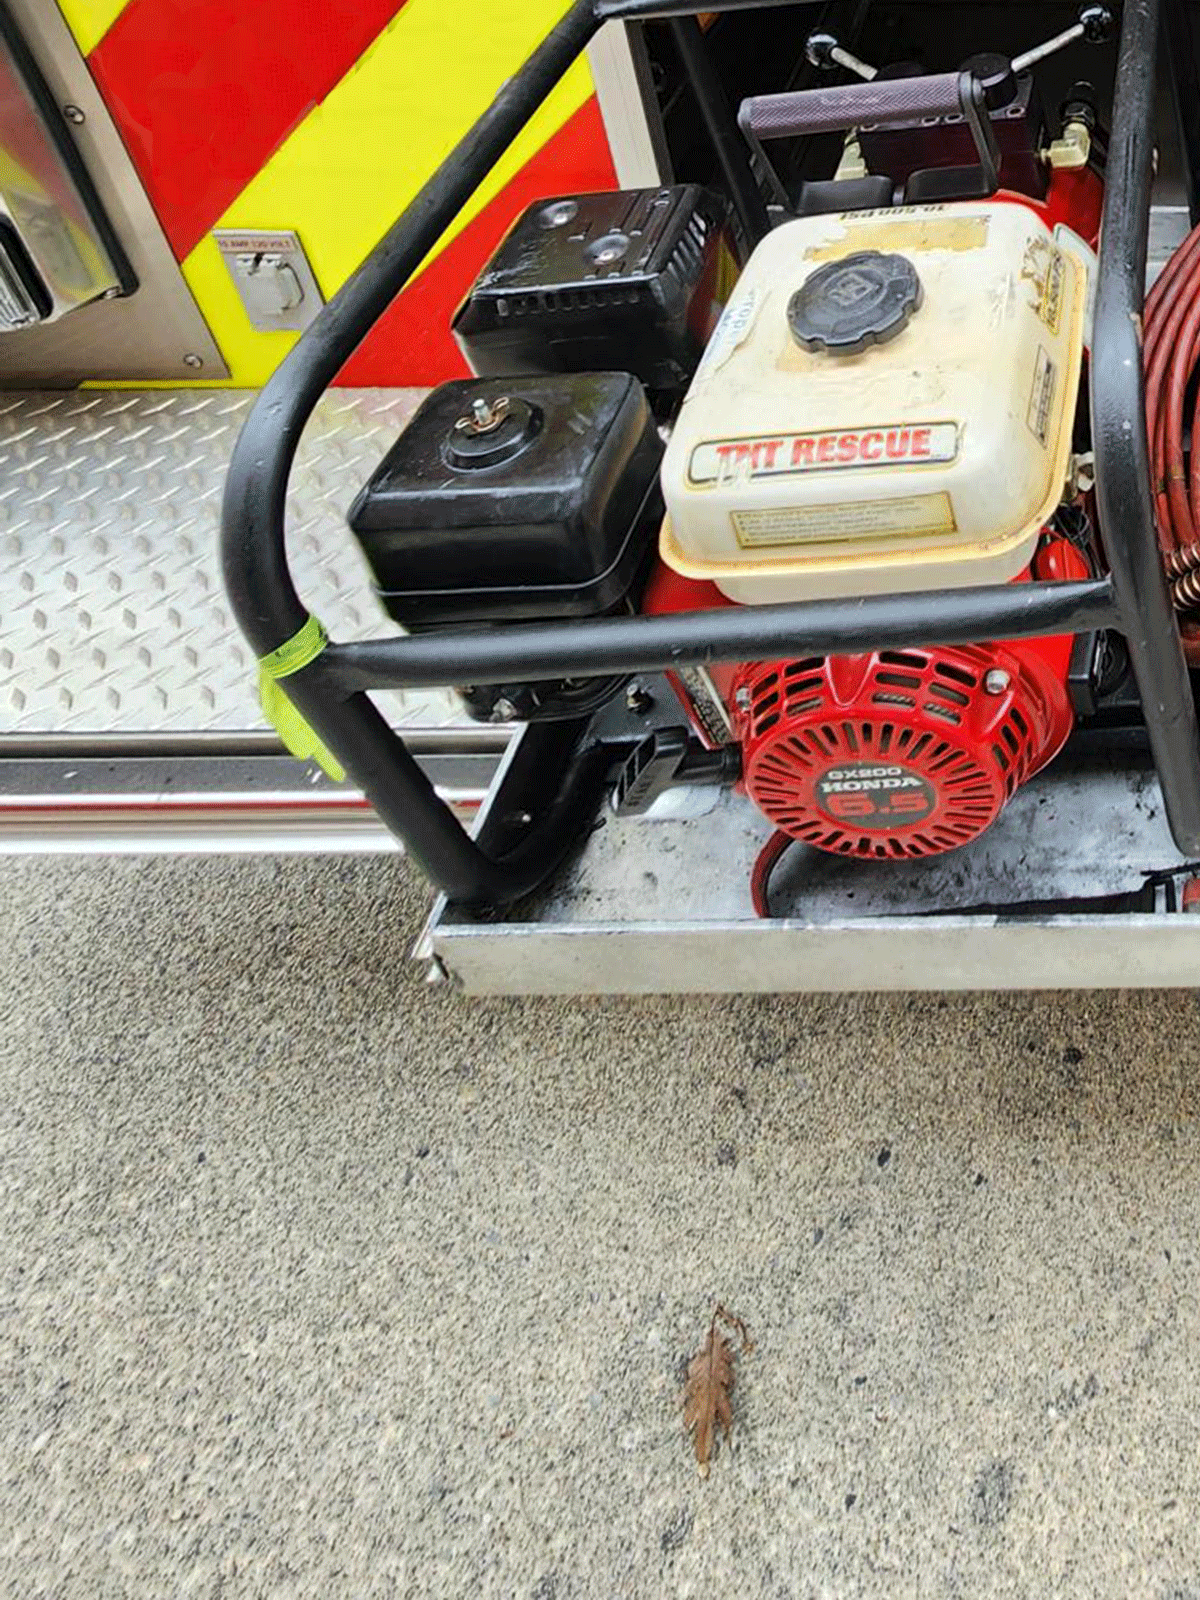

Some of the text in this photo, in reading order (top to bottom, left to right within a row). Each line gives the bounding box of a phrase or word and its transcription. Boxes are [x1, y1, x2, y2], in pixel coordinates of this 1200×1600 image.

[716, 428, 932, 470] TNT RESCUE
[828, 767, 902, 780] GX200
[820, 776, 923, 793] HONDA
[826, 792, 929, 817] 6.5
